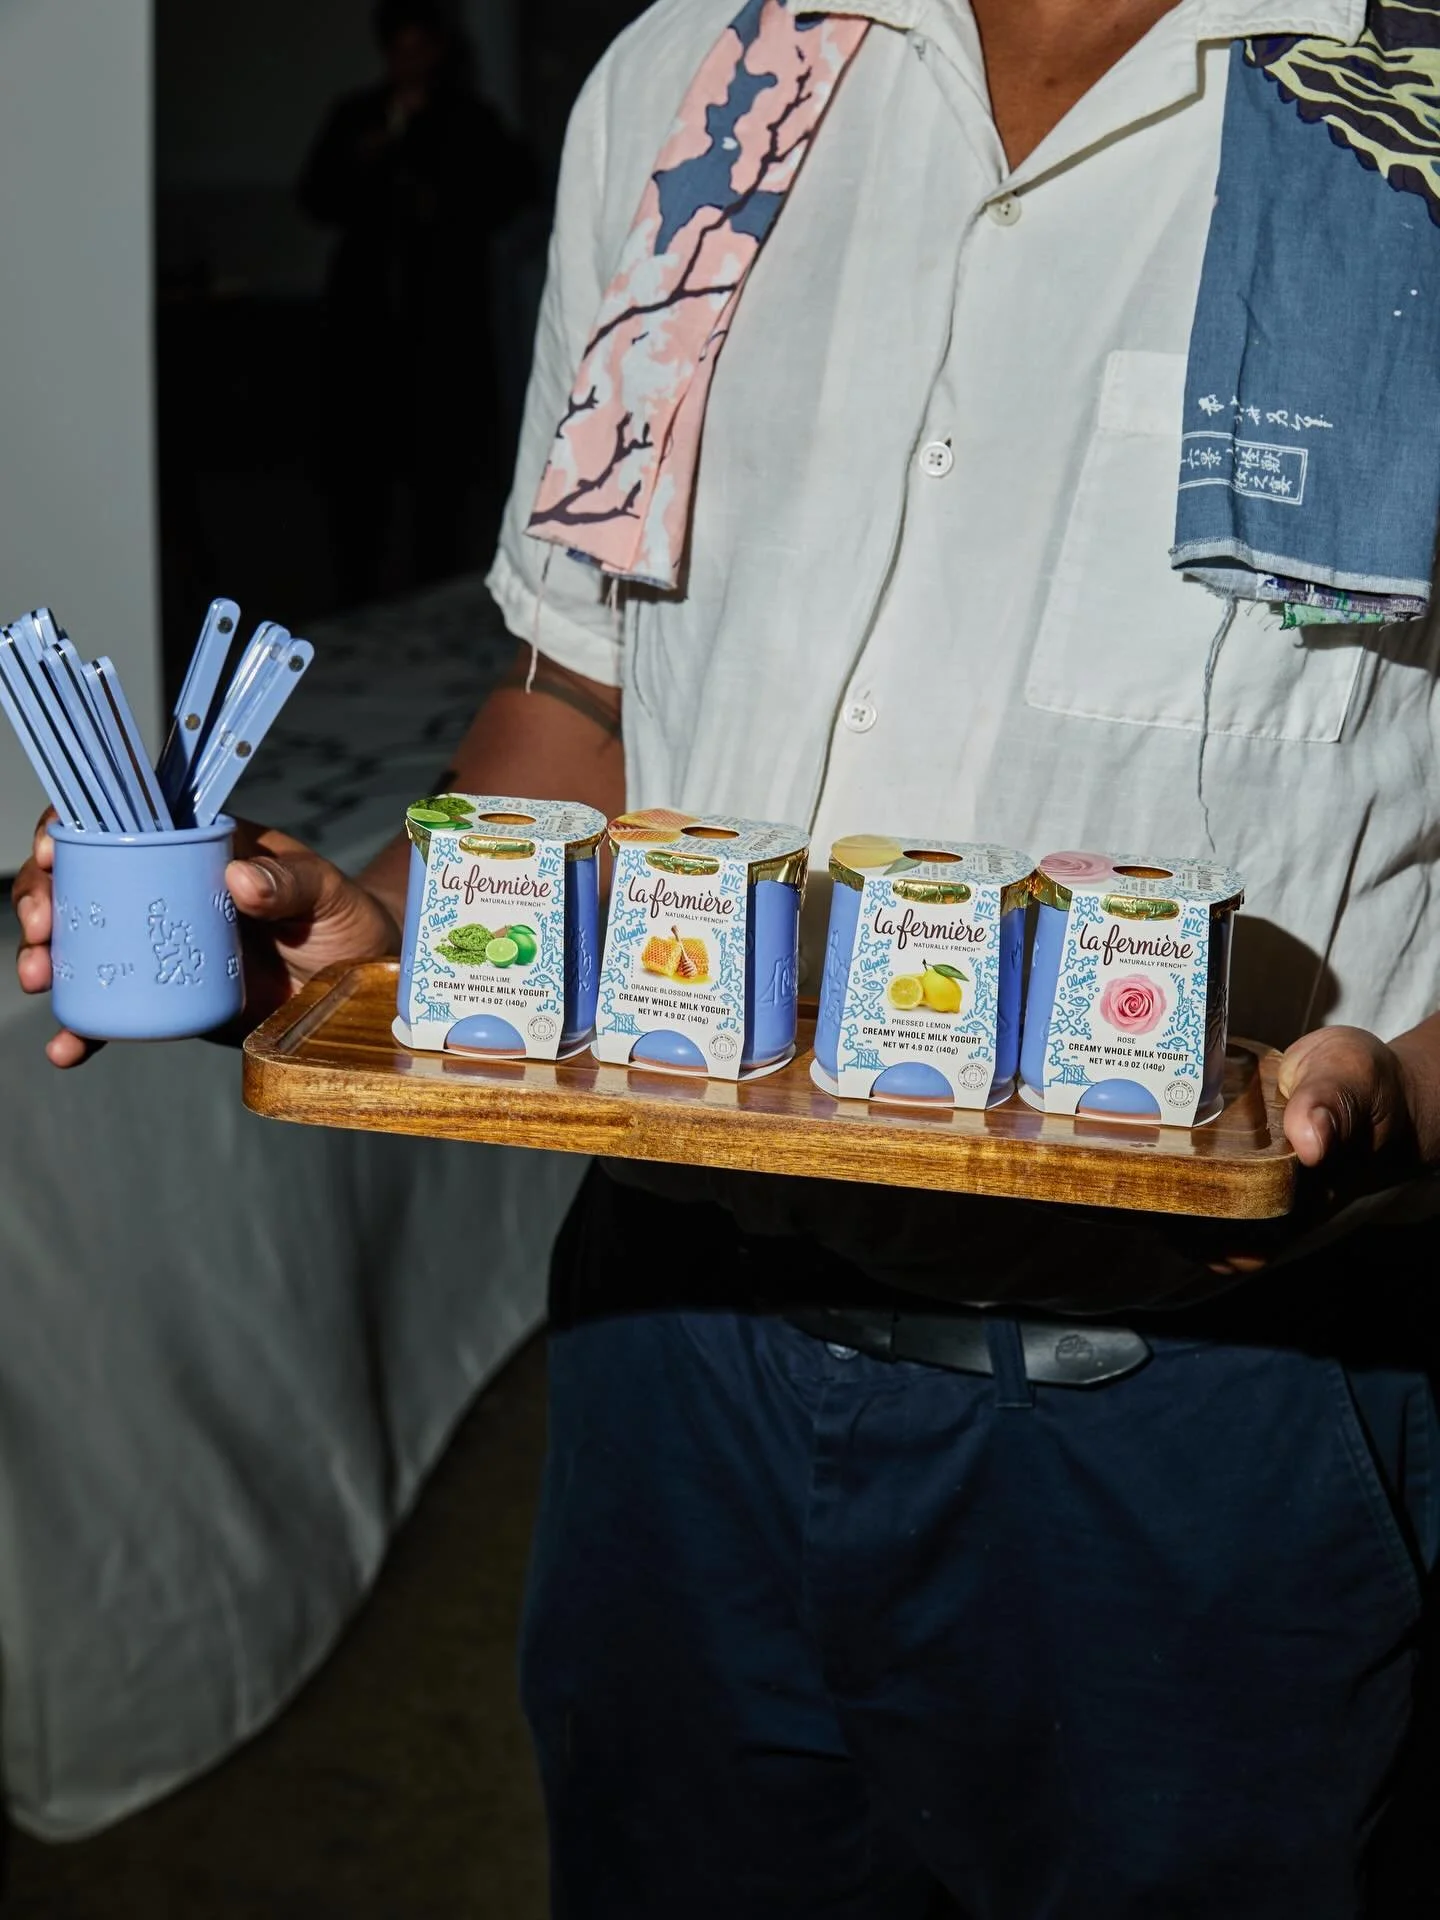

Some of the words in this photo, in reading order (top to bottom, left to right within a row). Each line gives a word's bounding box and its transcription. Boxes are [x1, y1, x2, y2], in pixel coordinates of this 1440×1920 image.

[540, 858, 559, 872] NYC
[462, 865, 551, 904] fermière
[722, 875, 742, 889] NYC
[481, 897, 515, 905] NATURALLY
[649, 879, 734, 918] fermière
[665, 911, 698, 920] NATURALLY
[976, 902, 996, 917] NYC
[897, 909, 987, 949] fermière
[1183, 918, 1204, 933] NYC
[913, 942, 949, 950] NATURALLY
[1103, 925, 1193, 966] fermière
[1119, 958, 1155, 966] NATURALLY
[470, 974, 494, 982] MATCHA
[434, 982, 465, 990] CREAMY
[468, 983, 495, 992] WHOLE
[497, 986, 515, 994] MILK
[518, 988, 549, 998] YOGURT
[631, 984, 658, 993] ORANGE
[660, 988, 692, 997] BLOSSOM
[694, 992, 716, 1001] HONEY
[619, 993, 650, 1003] CREAMY
[652, 997, 678, 1008] WHOLE
[680, 1001, 699, 1010] MILK
[701, 1004, 730, 1016] YOGURT
[638, 1008, 651, 1016] NET
[892, 1019, 924, 1028] PRESSED
[863, 1027, 895, 1037] CREAMY
[898, 1030, 925, 1039] WHOLE
[928, 1033, 948, 1042] MILK
[950, 1035, 982, 1045] YOGURT
[1069, 1043, 1101, 1052] CREAMY
[1104, 1046, 1132, 1056] WHOLE
[1134, 1049, 1154, 1058] MILK
[1157, 1051, 1189, 1061] YOGURT
